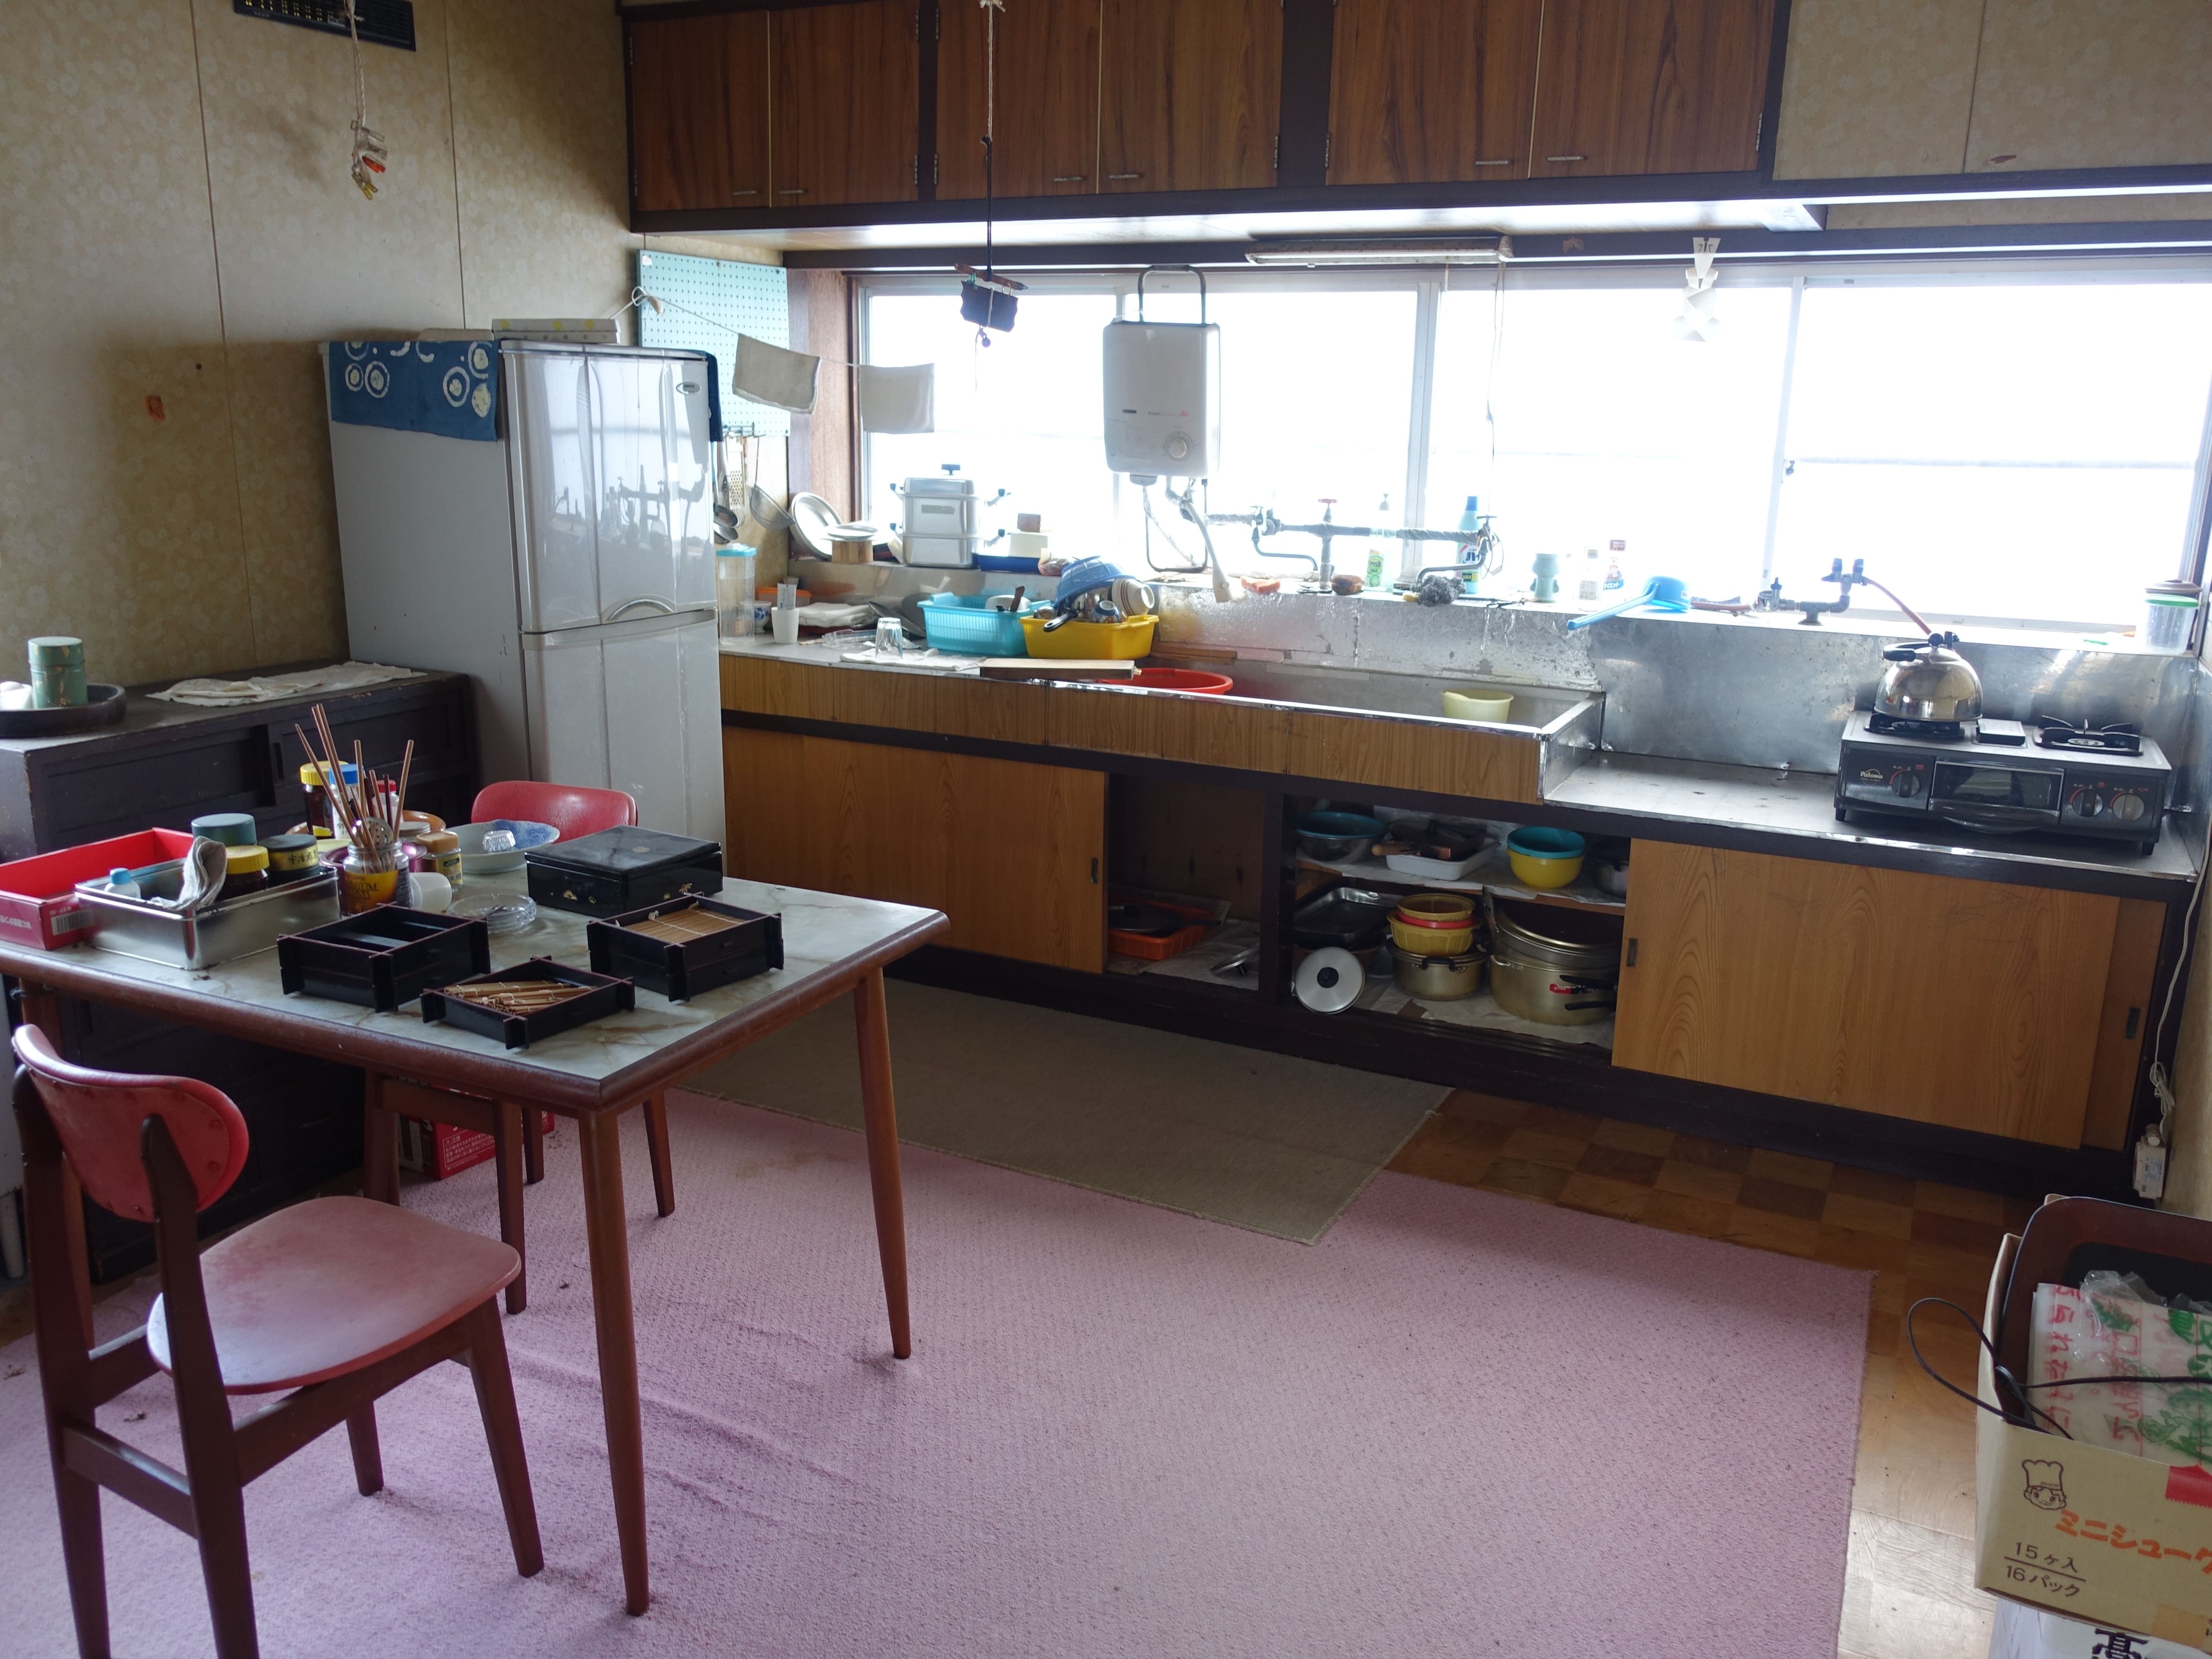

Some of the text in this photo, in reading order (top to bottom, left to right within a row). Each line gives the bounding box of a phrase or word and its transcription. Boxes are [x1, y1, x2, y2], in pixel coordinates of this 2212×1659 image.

[1860, 771, 1883, 779] Paloma
[2006, 1565, 2081, 1597] 16パック
